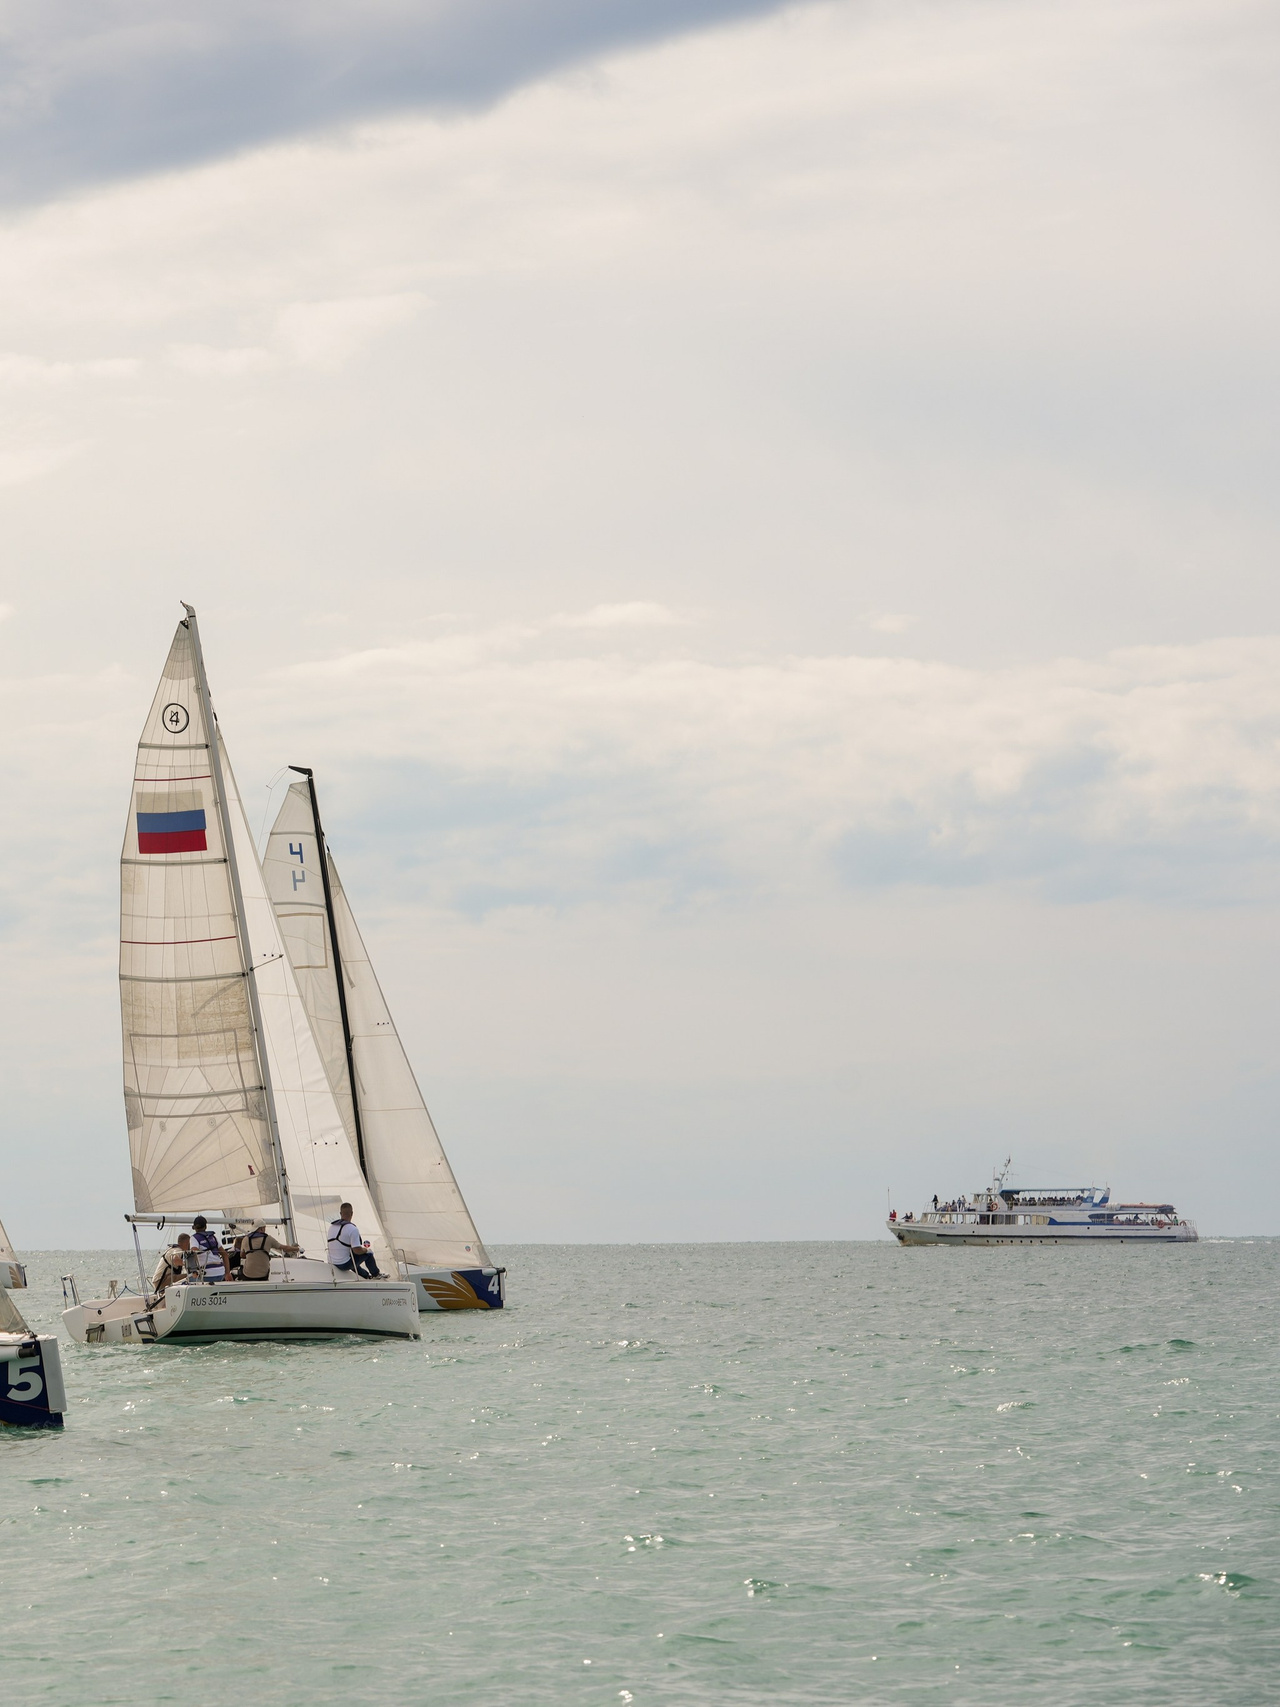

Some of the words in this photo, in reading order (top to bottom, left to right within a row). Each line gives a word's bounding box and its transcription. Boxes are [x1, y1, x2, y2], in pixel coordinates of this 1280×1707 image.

[288, 842, 304, 864] 4
[175, 1290, 182, 1299] 4
[487, 1273, 500, 1295] 4
[190, 1297, 207, 1307] RUS
[208, 1296, 227, 1306] 3014
[6, 1354, 43, 1402] 5
